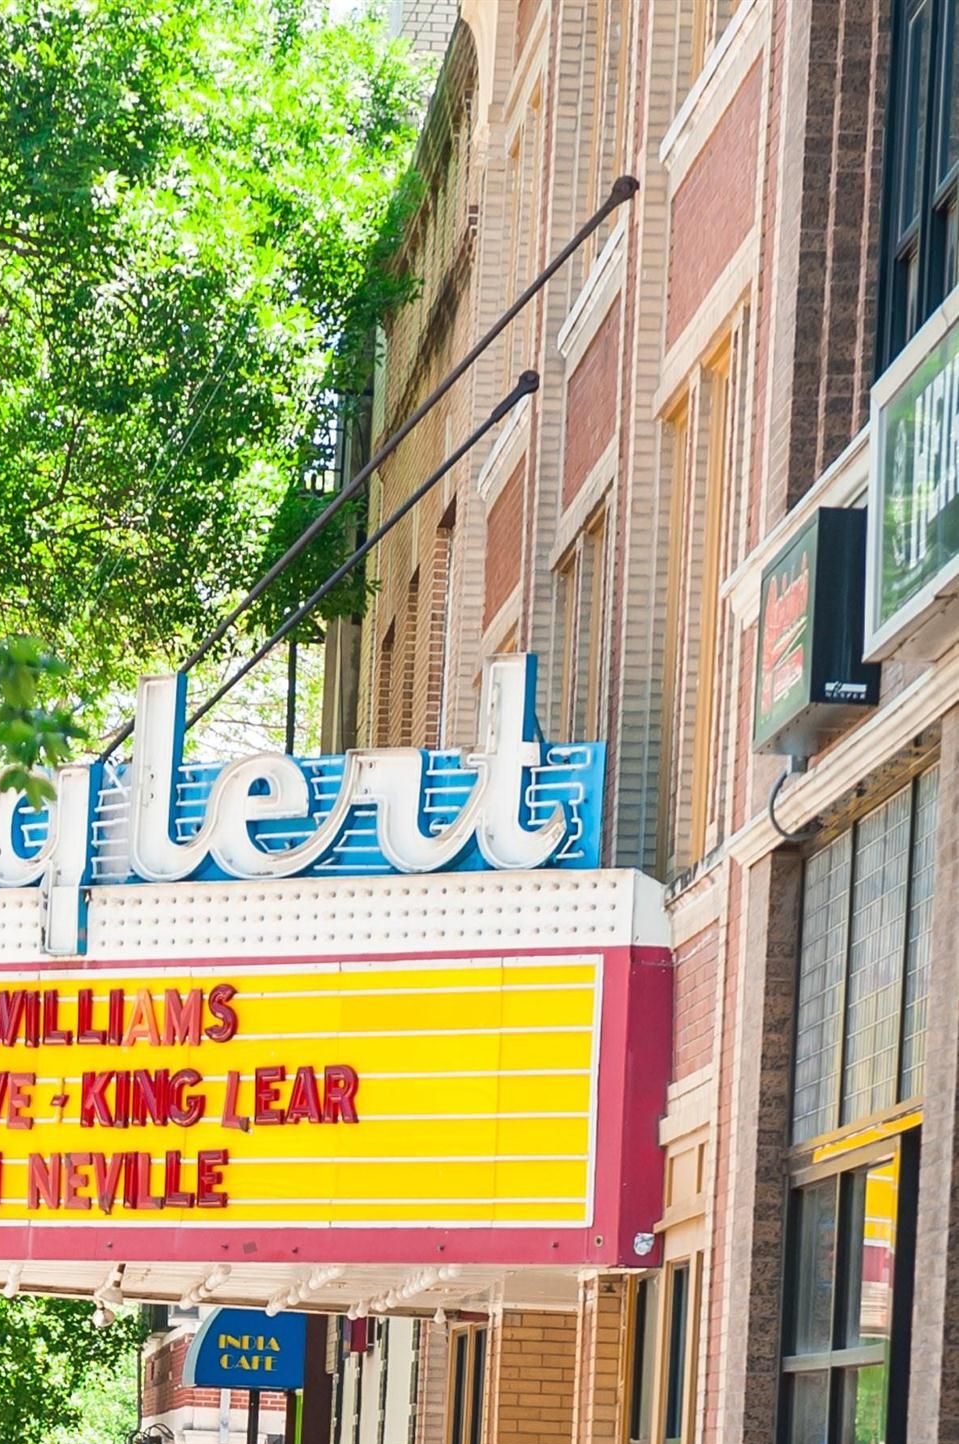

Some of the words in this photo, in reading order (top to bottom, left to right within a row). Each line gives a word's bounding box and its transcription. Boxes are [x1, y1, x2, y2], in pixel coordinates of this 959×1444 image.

[80, 1068, 203, 1127] KING
[220, 1064, 360, 1133] LEAR
[27, 1148, 230, 1212] NEVILLE
[218, 1334, 280, 1351] INDIA
[220, 1354, 278, 1371] CAFE
